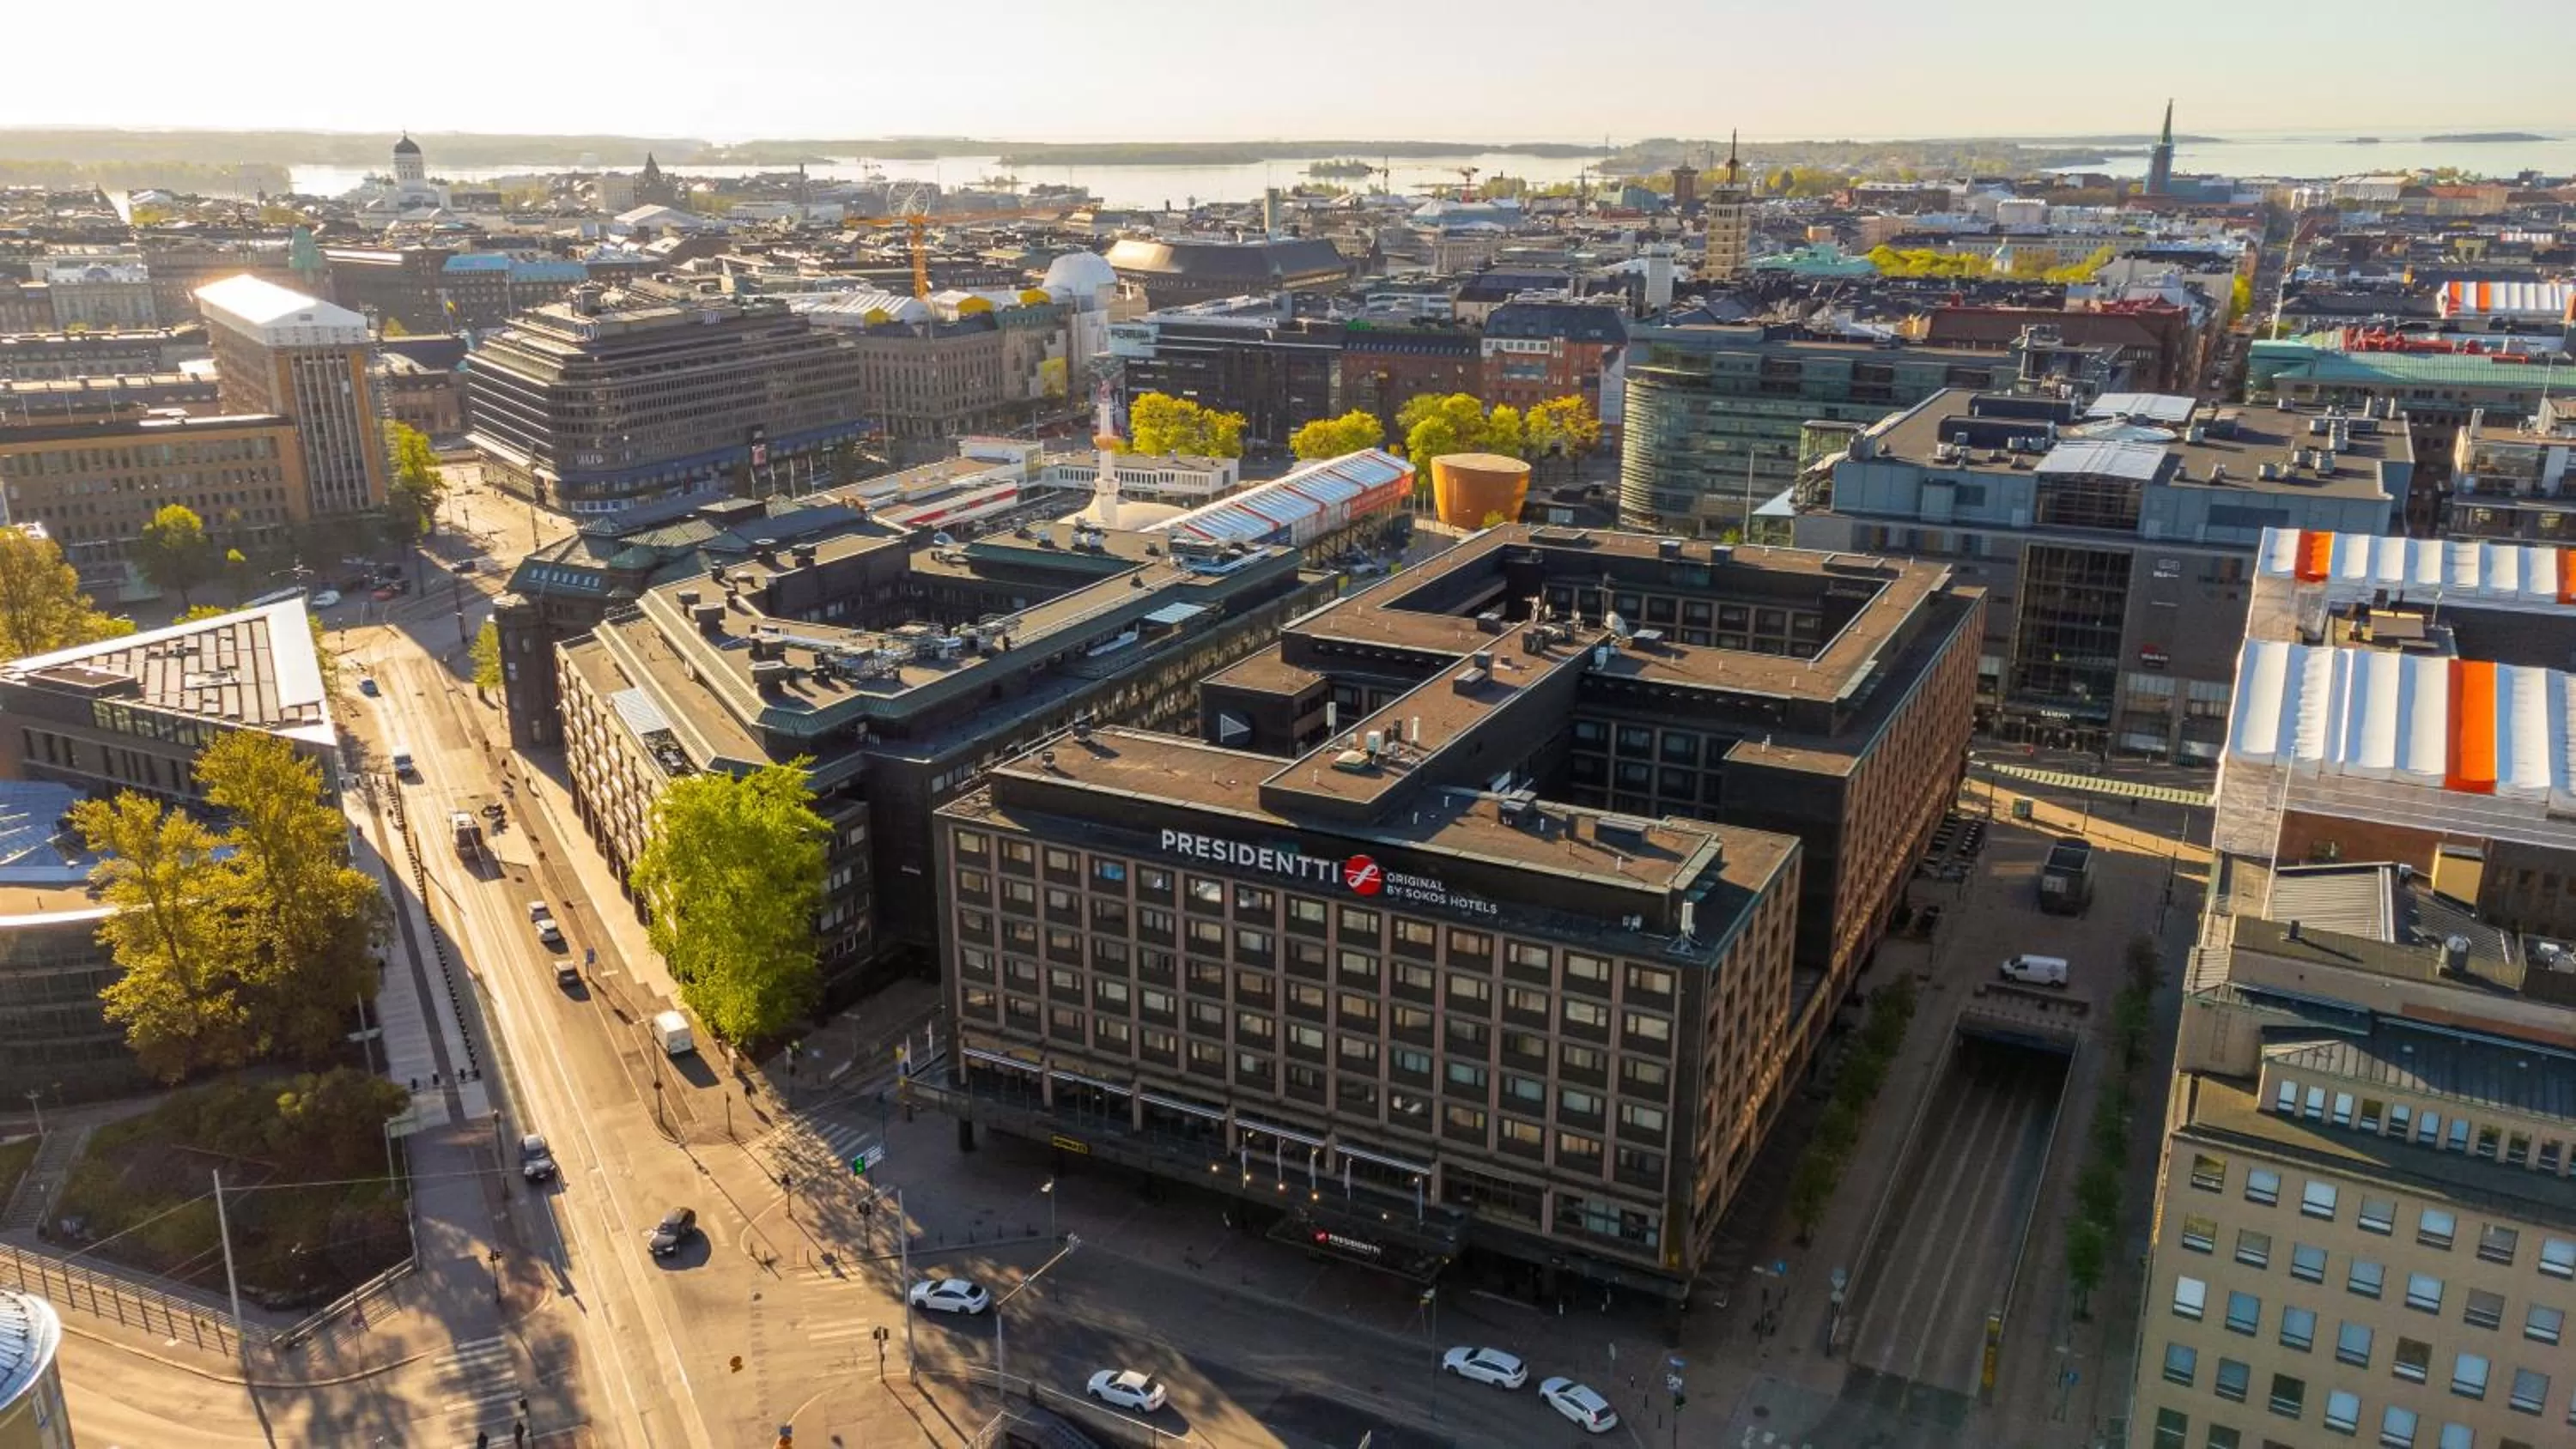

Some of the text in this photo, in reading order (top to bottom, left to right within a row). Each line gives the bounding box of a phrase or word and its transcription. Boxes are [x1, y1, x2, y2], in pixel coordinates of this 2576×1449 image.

[1162, 829, 1339, 883] PRESIDENTTI
[1387, 872, 1445, 892] ORIGINAL
[1387, 884, 1498, 914] BY SOKOS HOTELS
